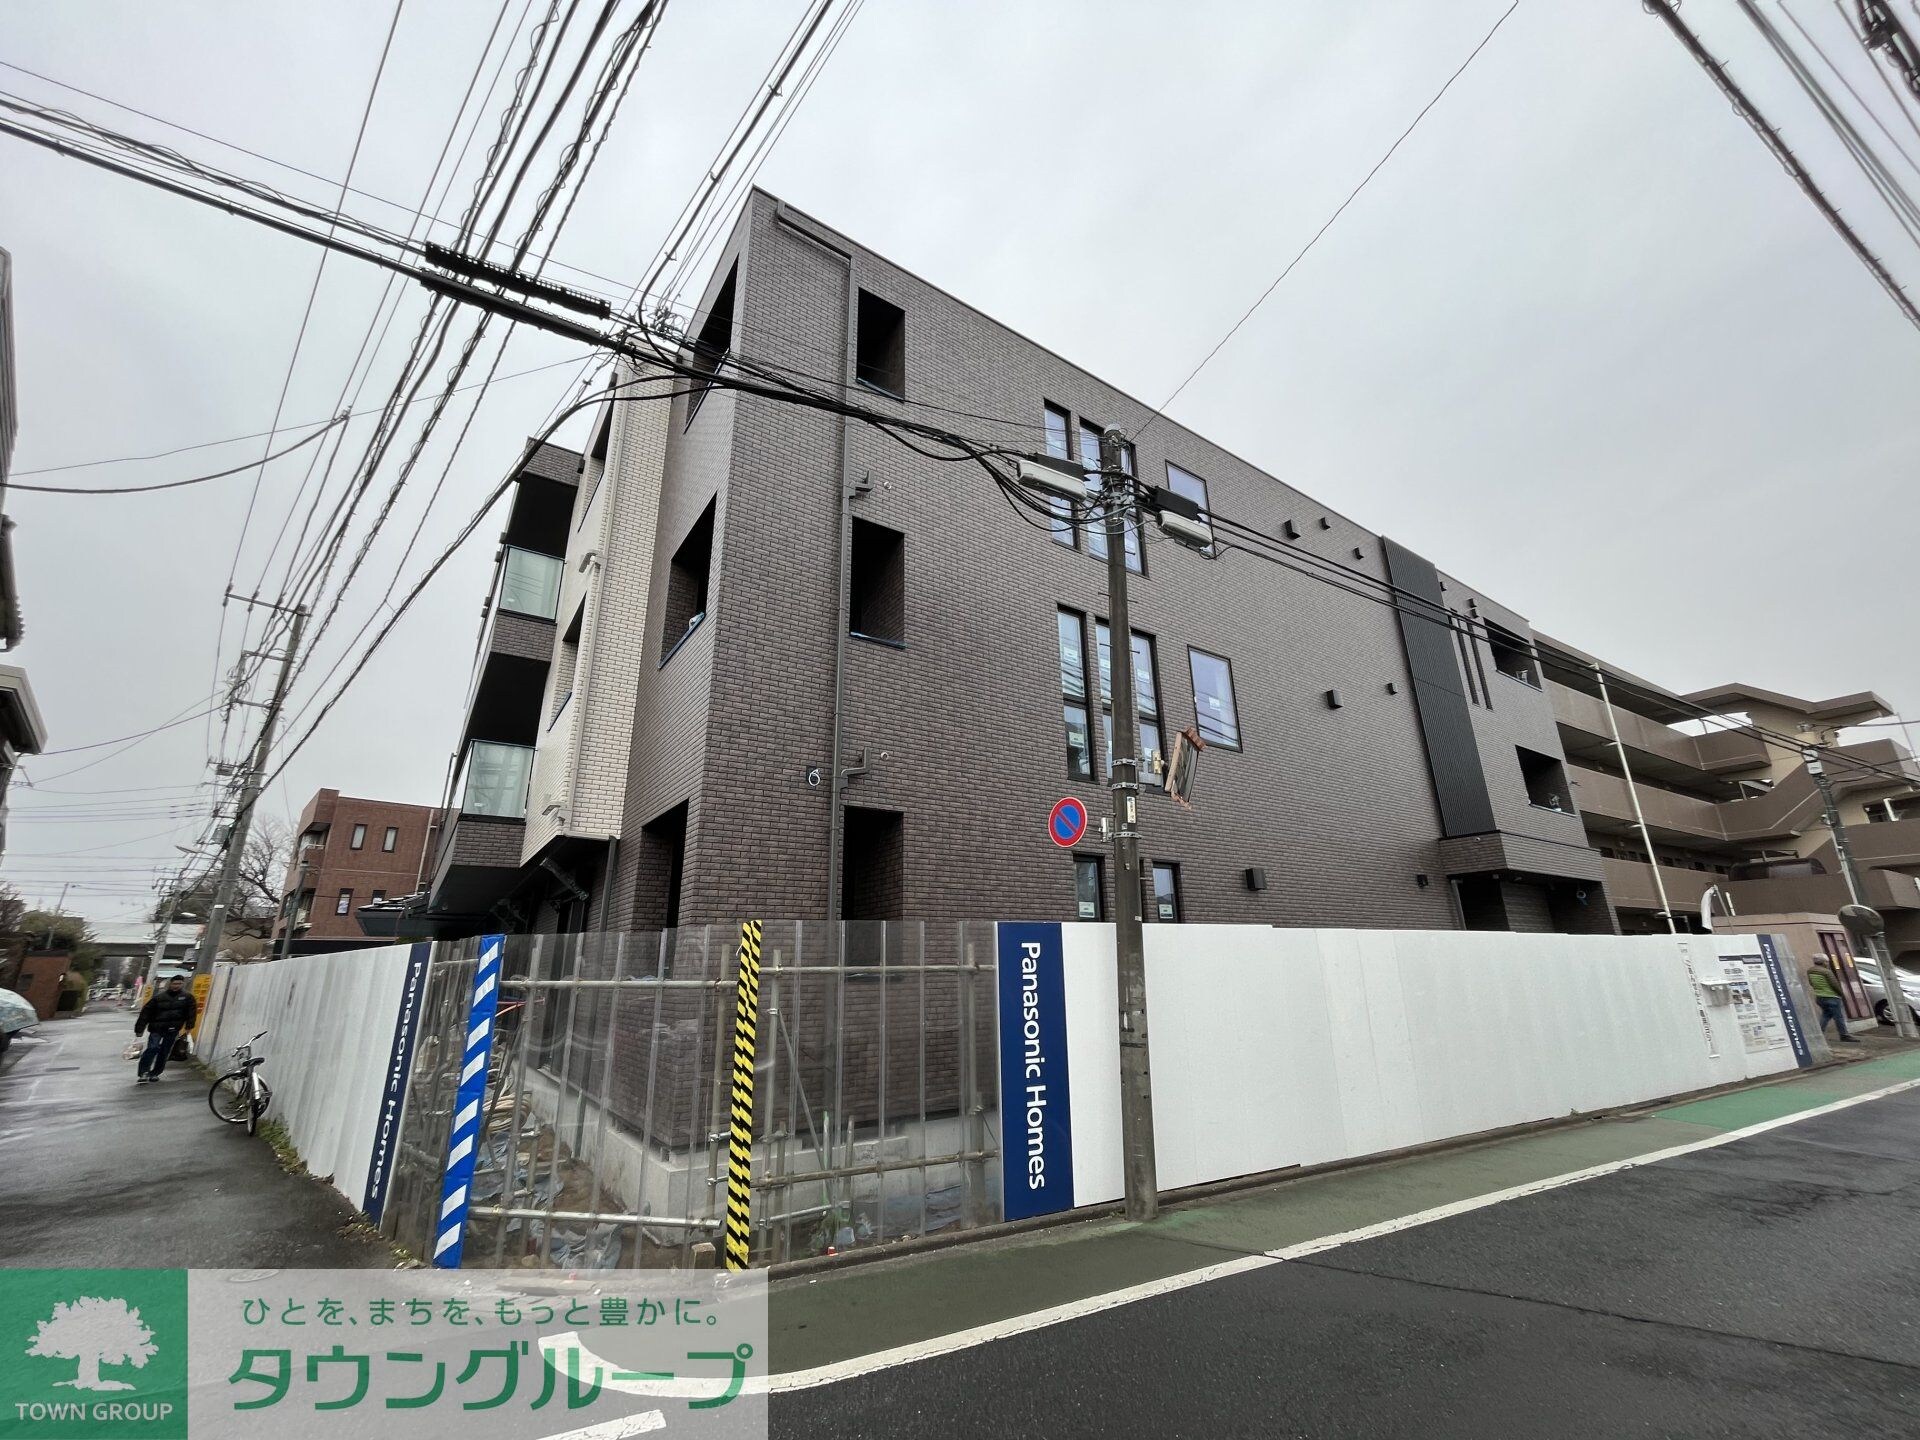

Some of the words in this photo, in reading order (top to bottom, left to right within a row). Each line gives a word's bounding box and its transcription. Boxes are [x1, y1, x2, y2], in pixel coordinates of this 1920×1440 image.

[390, 962, 422, 1092] Panasonic
[1021, 942, 1045, 1079] Panasonic
[1763, 943, 1788, 1007] Panasonic
[1785, 1009, 1804, 1056] Homes
[371, 1099, 396, 1199] Homes
[1026, 1084, 1047, 1190] Homes
